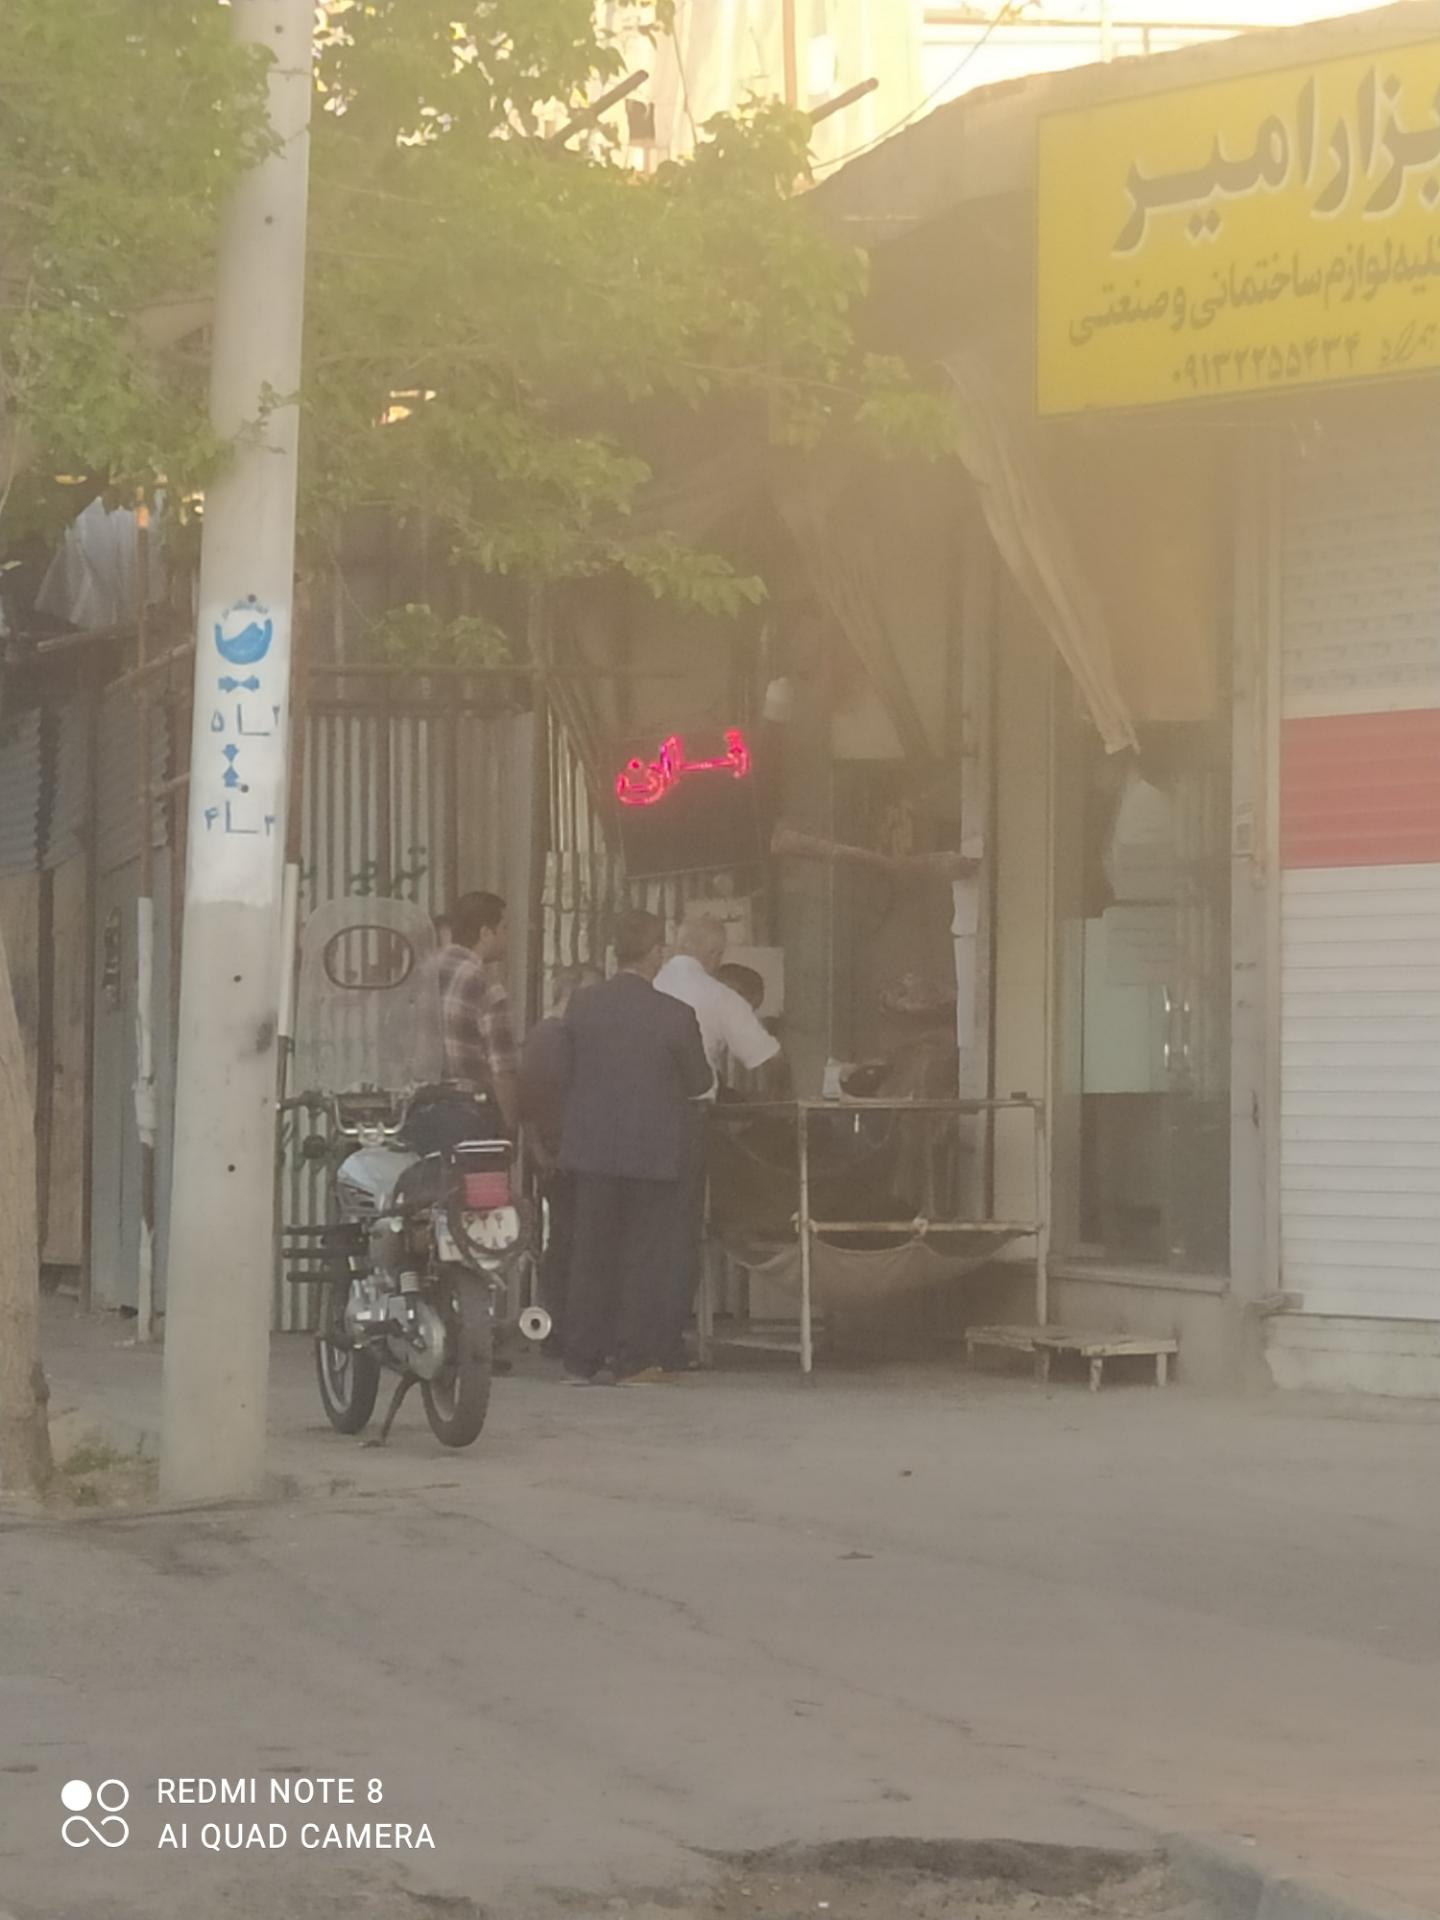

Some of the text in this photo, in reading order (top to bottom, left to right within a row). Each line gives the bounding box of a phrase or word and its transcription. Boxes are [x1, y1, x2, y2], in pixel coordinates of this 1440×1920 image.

[1111, 74, 1316, 253] امیر
[1169, 286, 1186, 333] و
[1190, 250, 1322, 329] ساختمانی
[1323, 236, 1392, 311] لوازم
[1068, 278, 1168, 346] صنعتی
